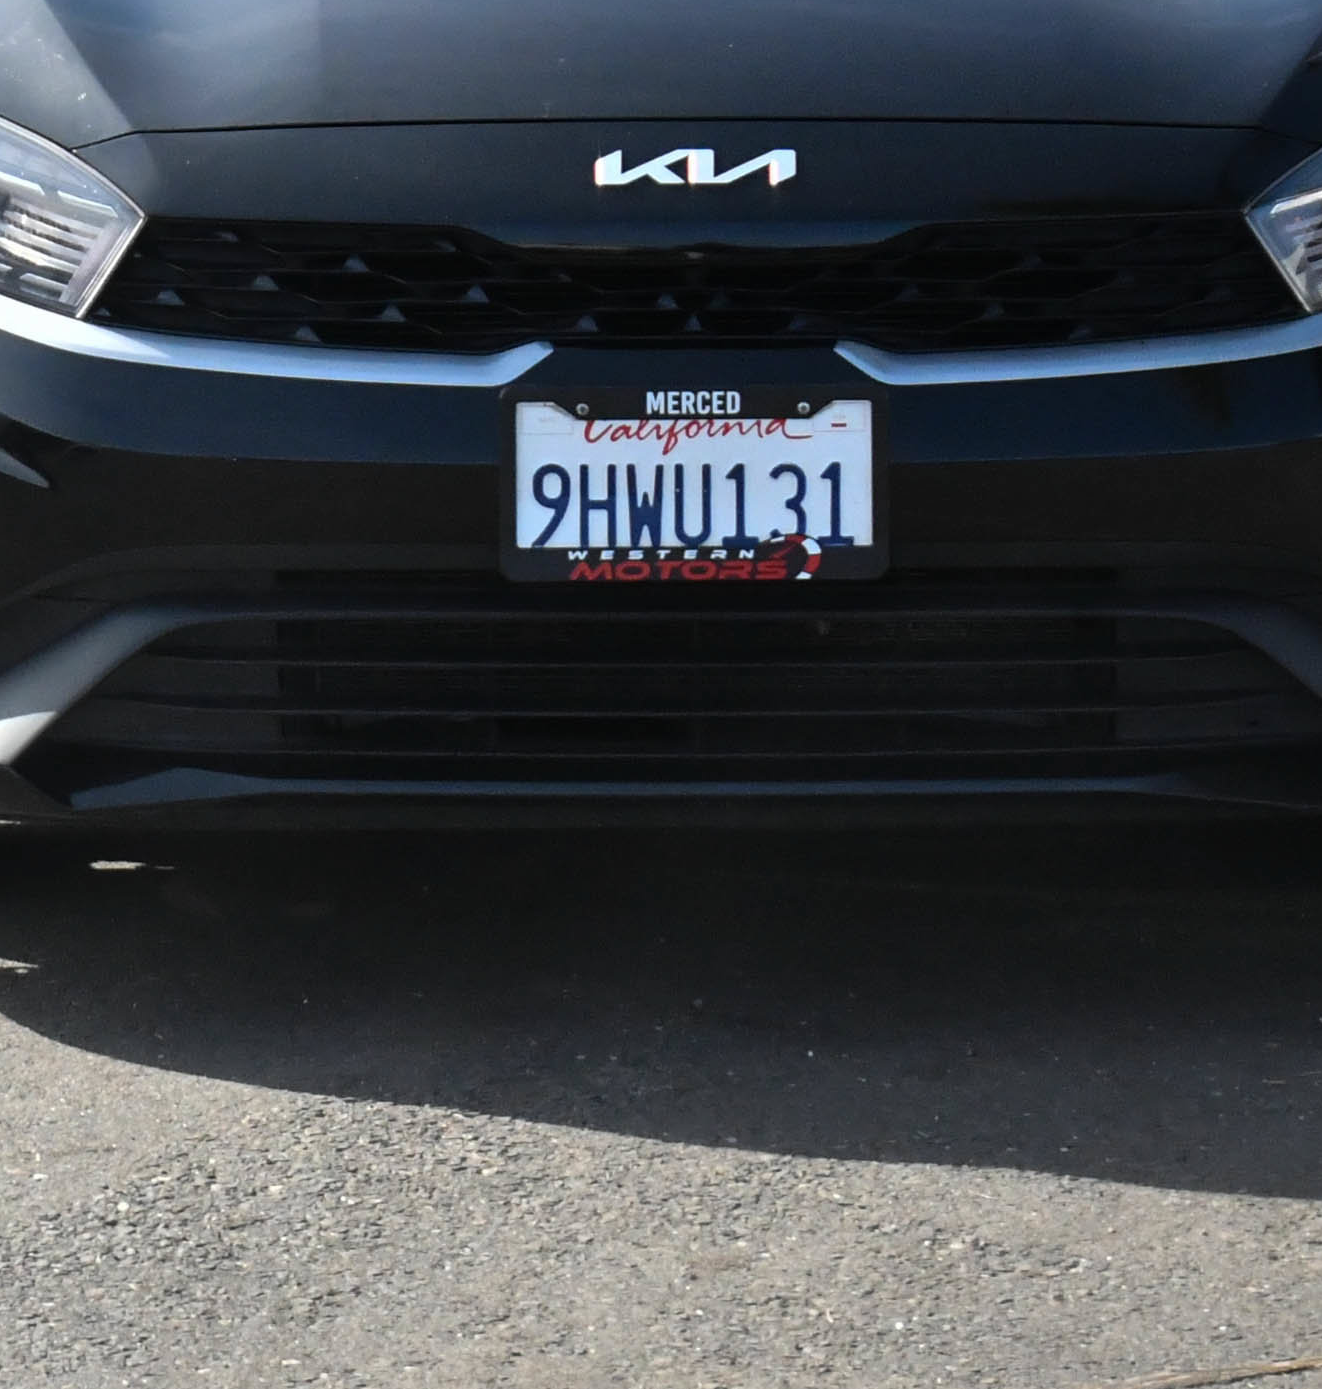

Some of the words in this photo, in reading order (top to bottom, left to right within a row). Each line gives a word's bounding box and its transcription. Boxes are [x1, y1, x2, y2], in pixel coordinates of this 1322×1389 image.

[646, 390, 741, 415] MERCED
[584, 418, 814, 456] California
[531, 461, 855, 549] 9HWU131
[567, 548, 756, 561] WESTERN
[569, 560, 789, 581] MOTORS
